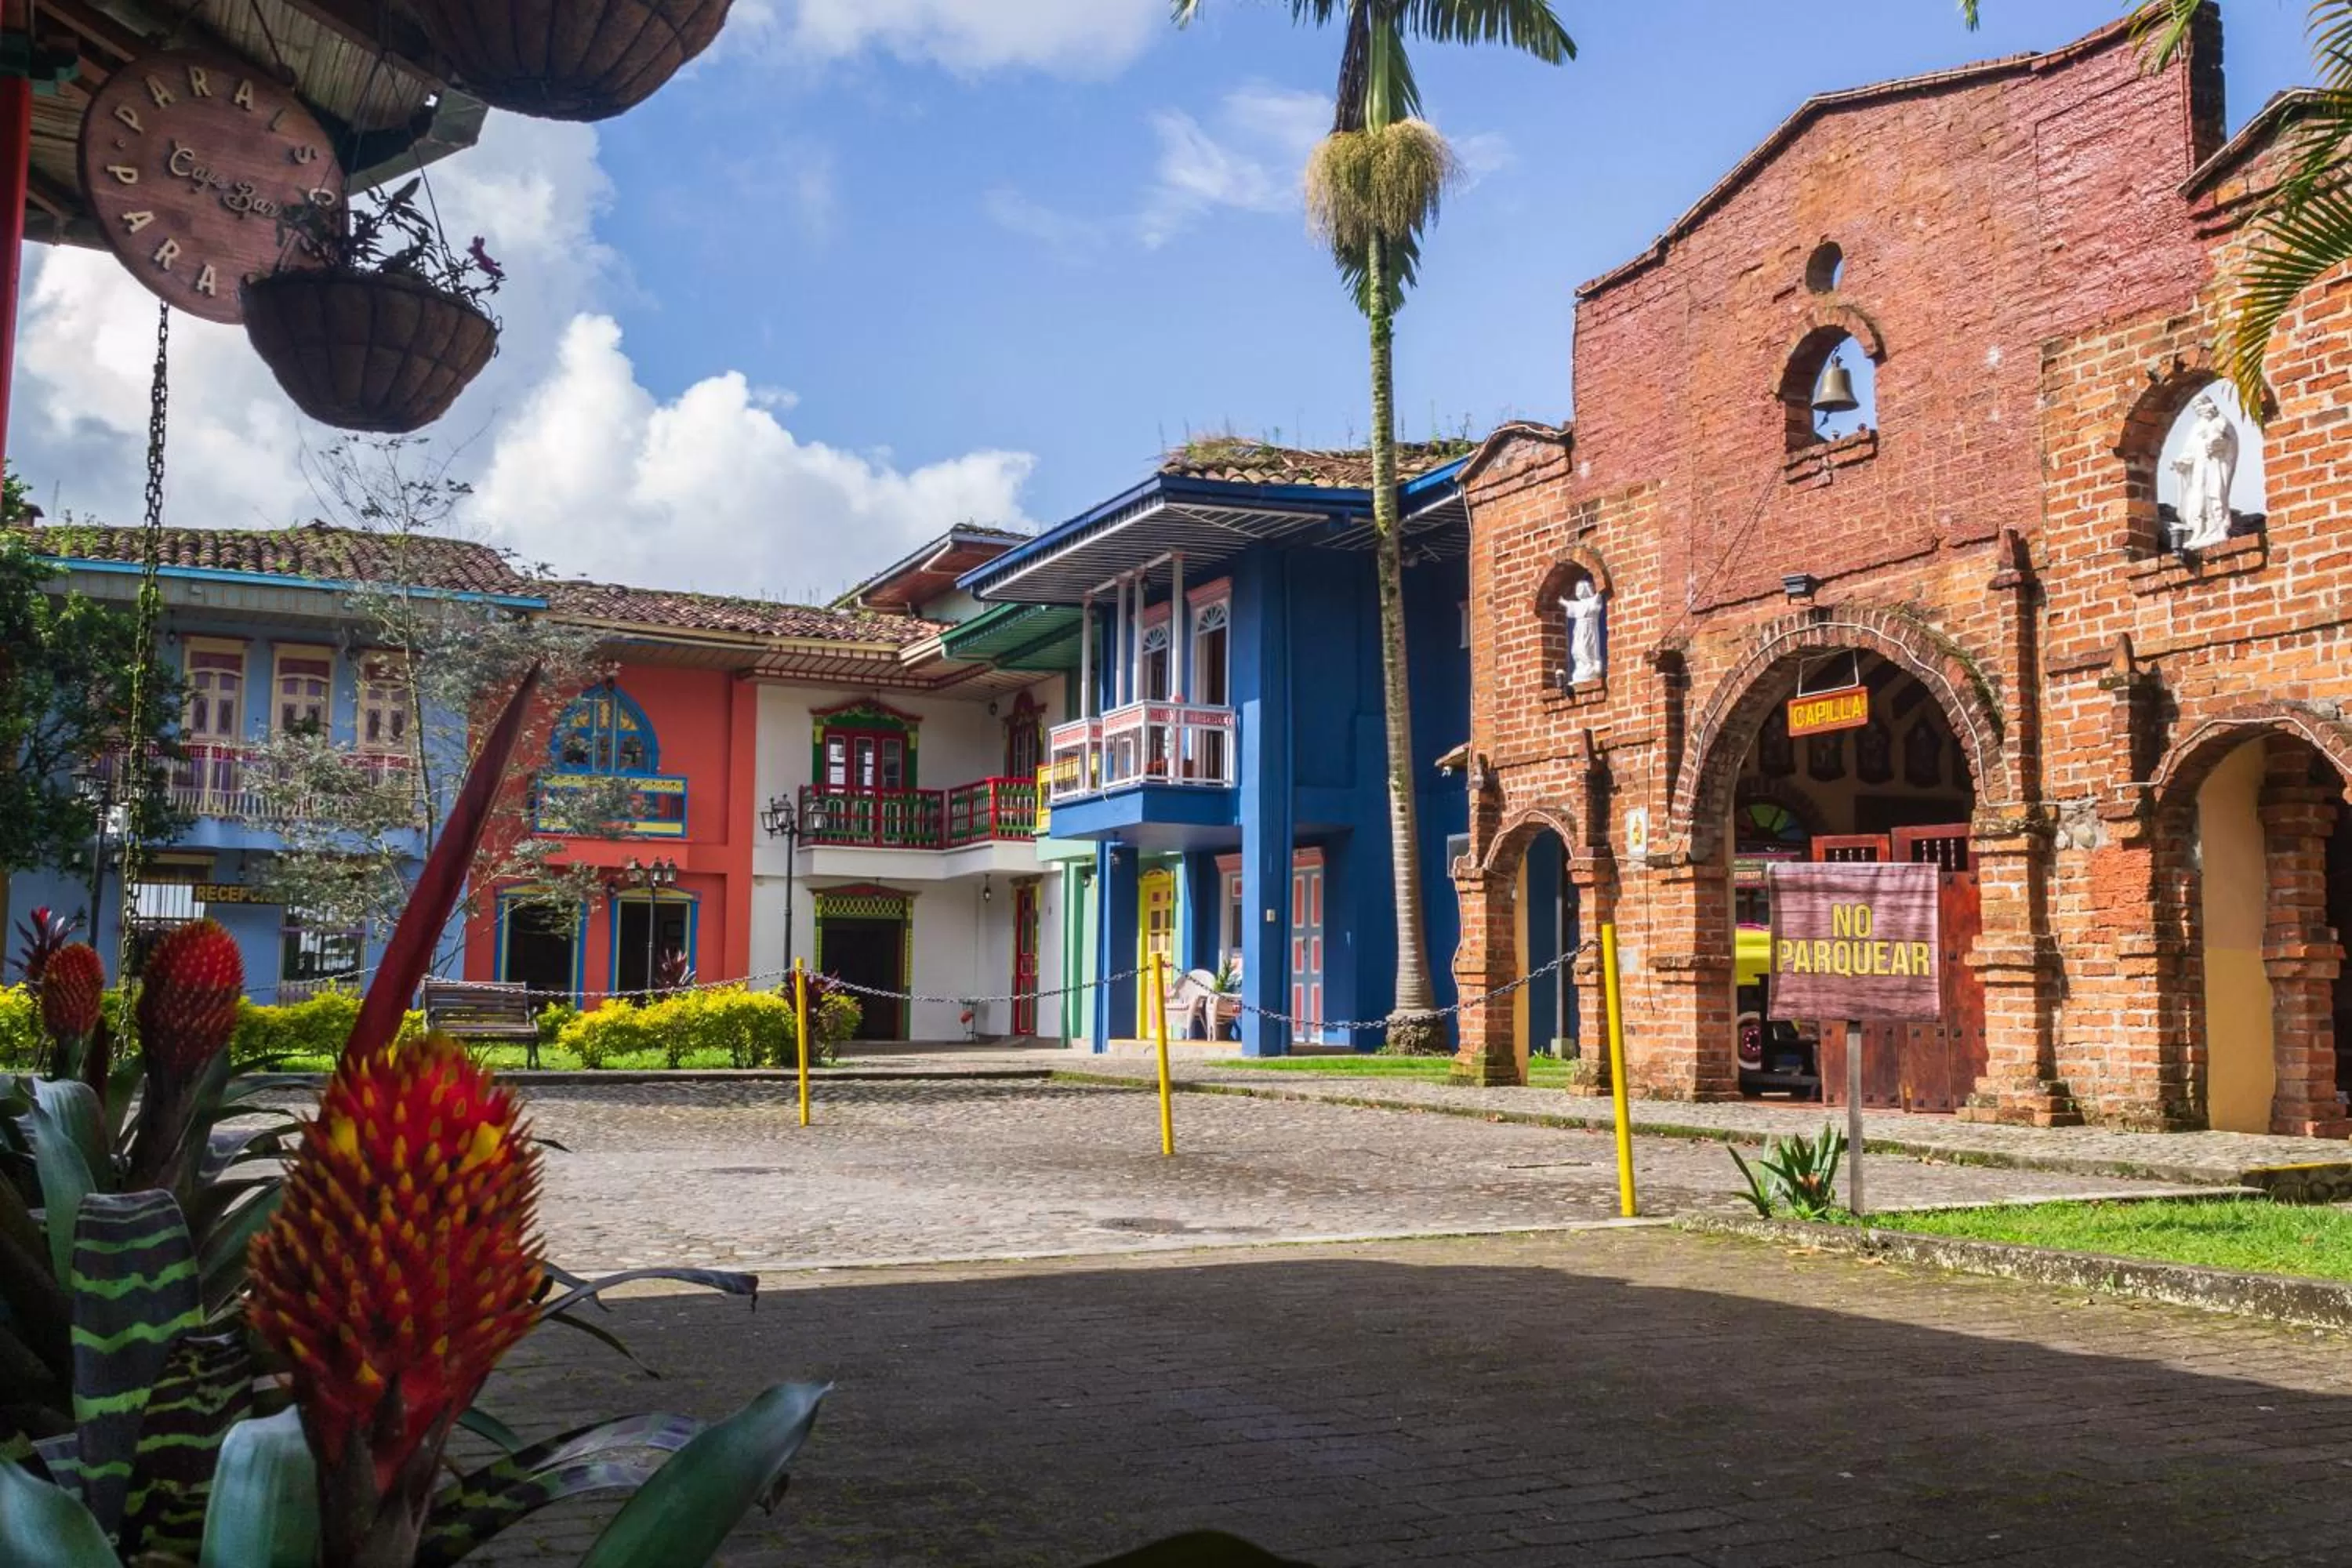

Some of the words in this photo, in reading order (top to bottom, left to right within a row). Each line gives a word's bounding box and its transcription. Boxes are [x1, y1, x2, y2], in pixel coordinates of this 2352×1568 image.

[223, 180, 281, 217] Bar
[1793, 695, 1863, 728] CAPILLA
[1831, 903, 1872, 938] NO
[1776, 939, 1930, 978] PARQUEAR
